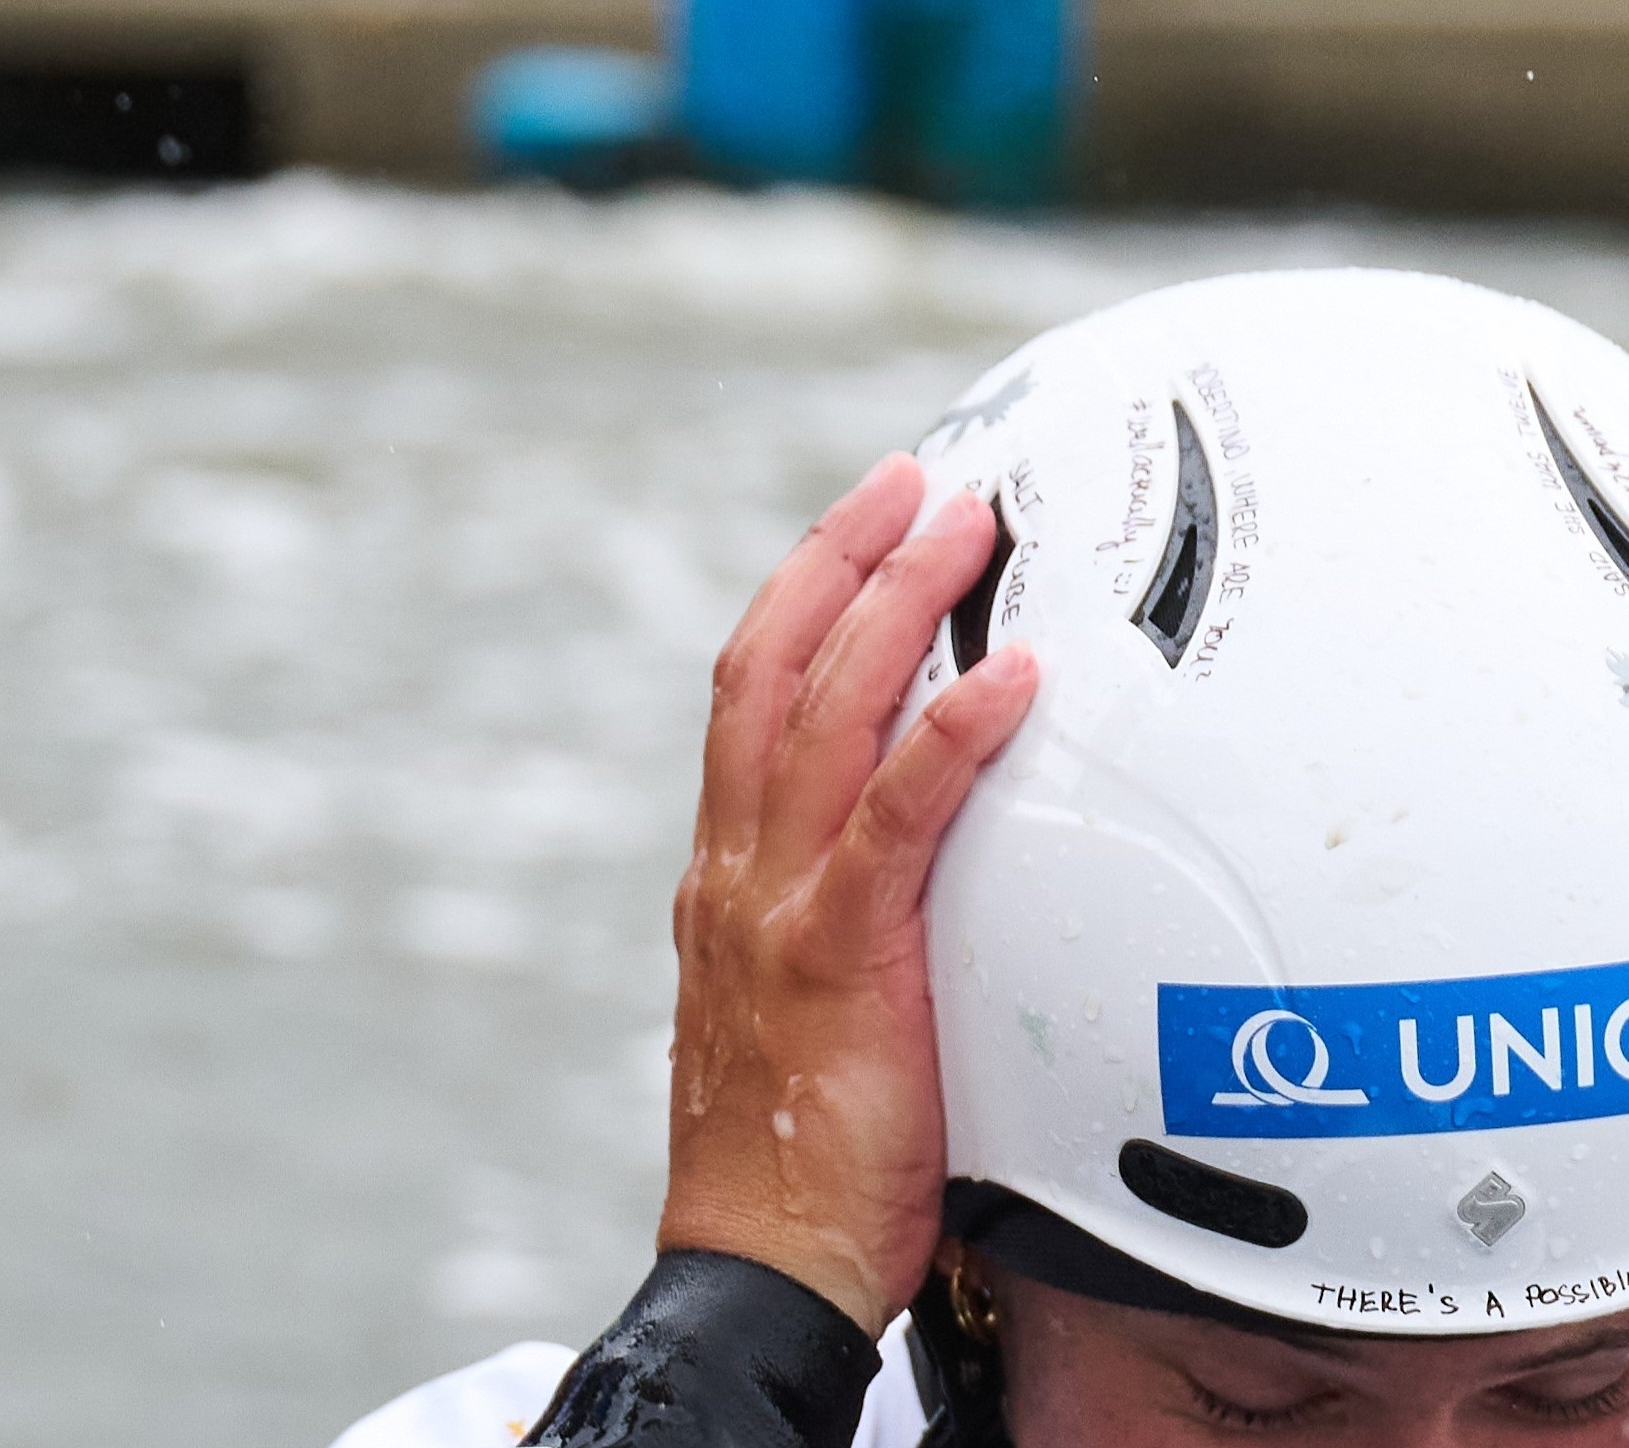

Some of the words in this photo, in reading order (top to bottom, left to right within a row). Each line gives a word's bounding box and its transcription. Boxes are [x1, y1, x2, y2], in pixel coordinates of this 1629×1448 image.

[1009, 458, 1043, 513] SALT
[1527, 451, 1562, 491] WAS
[1228, 473, 1260, 550] WHERE
[1555, 500, 1586, 536] SHE
[1001, 540, 1039, 627] CUBE
[1218, 561, 1251, 605] ARE
[1311, 1283, 1459, 1314] THERE'S
[1485, 1290, 1505, 1318] A
